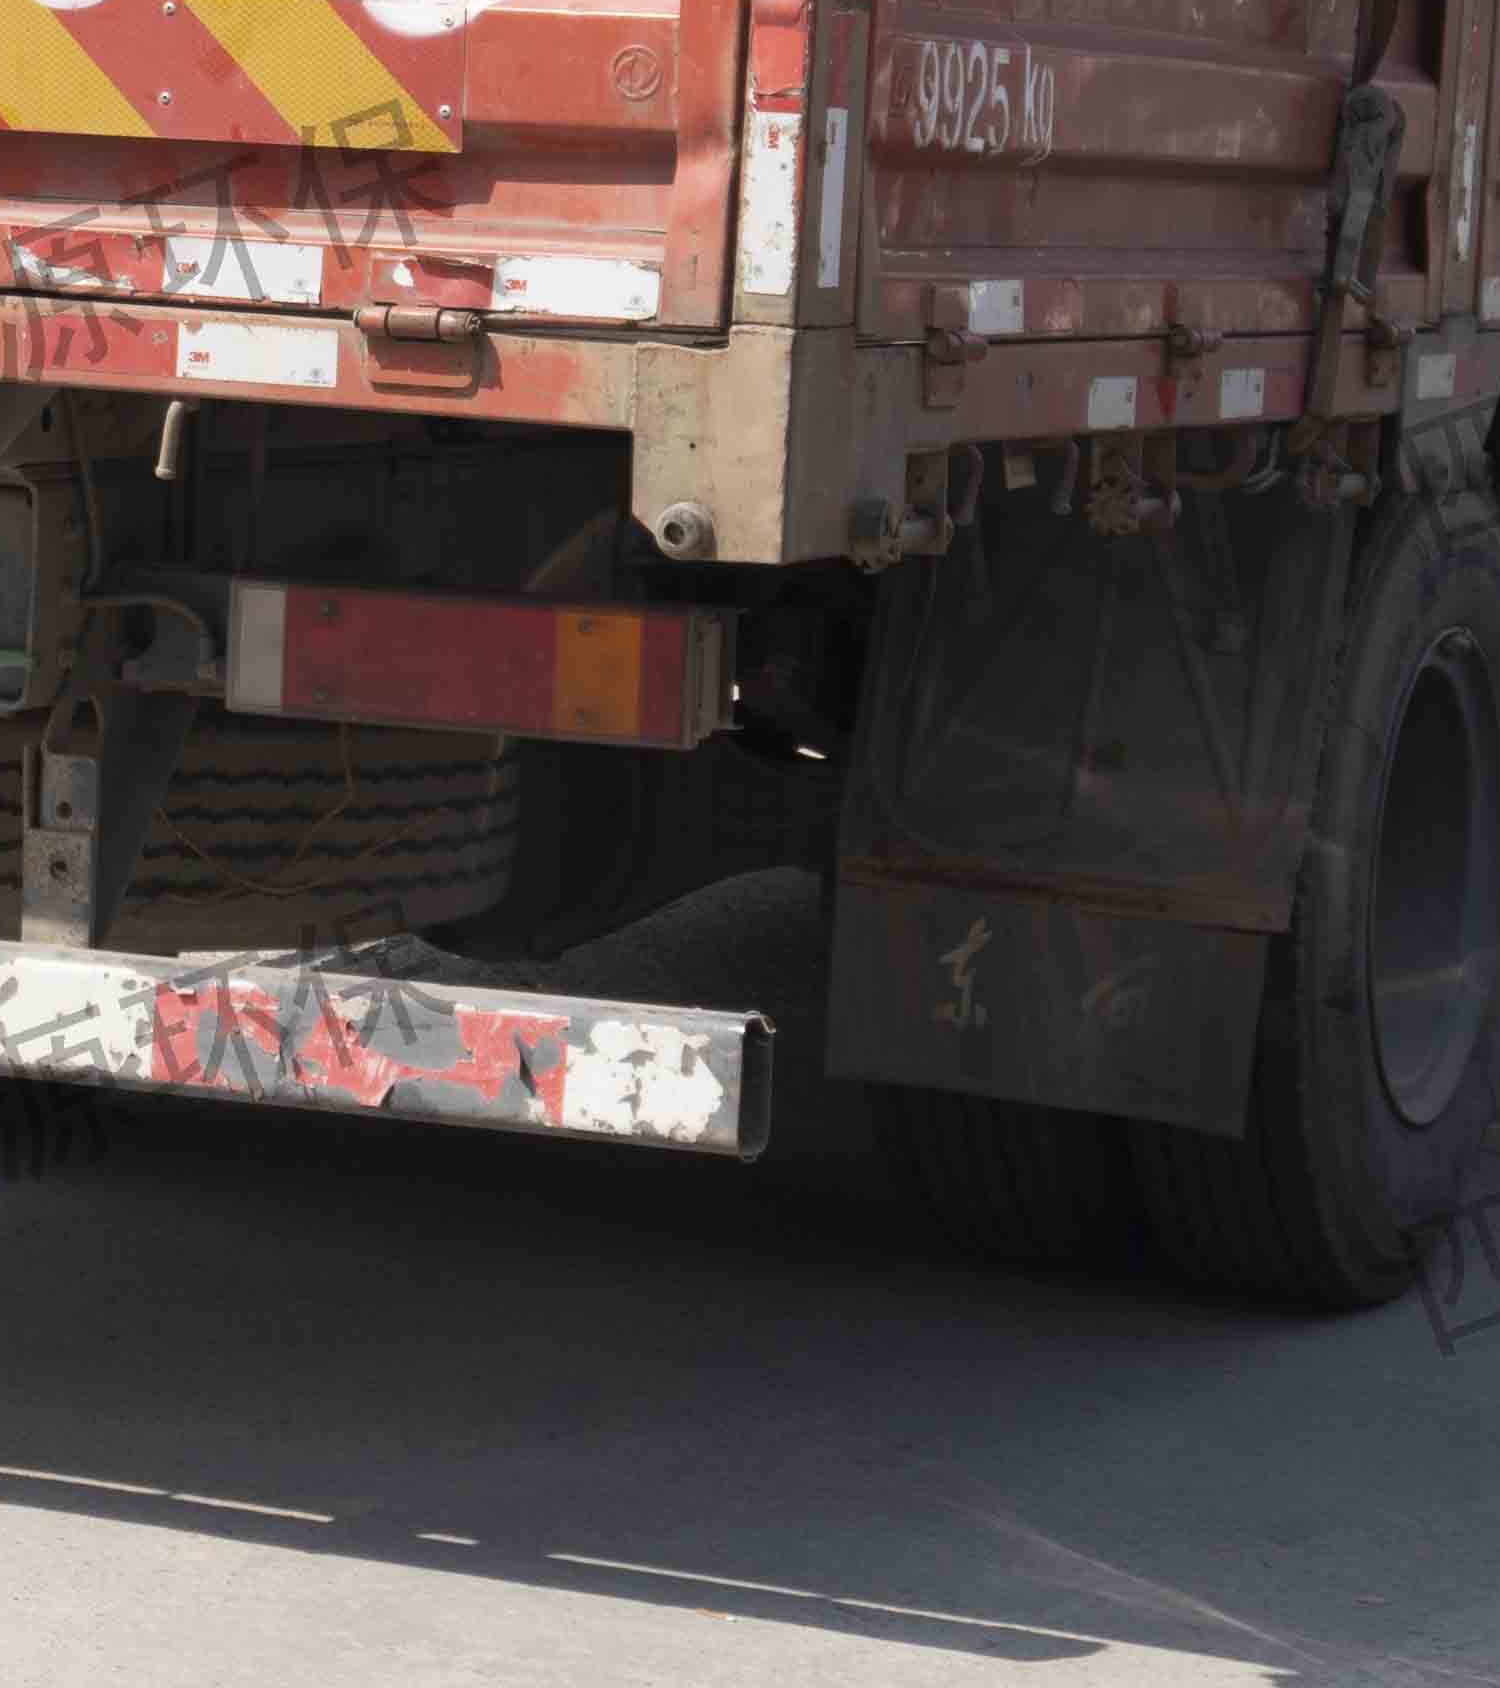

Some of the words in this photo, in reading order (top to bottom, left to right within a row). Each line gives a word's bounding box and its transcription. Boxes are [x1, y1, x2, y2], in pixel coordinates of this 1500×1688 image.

[914, 40, 1010, 154] 9925
[1021, 43, 1055, 166] kg
[175, 262, 197, 273] 3M
[188, 351, 211, 363] 3M
